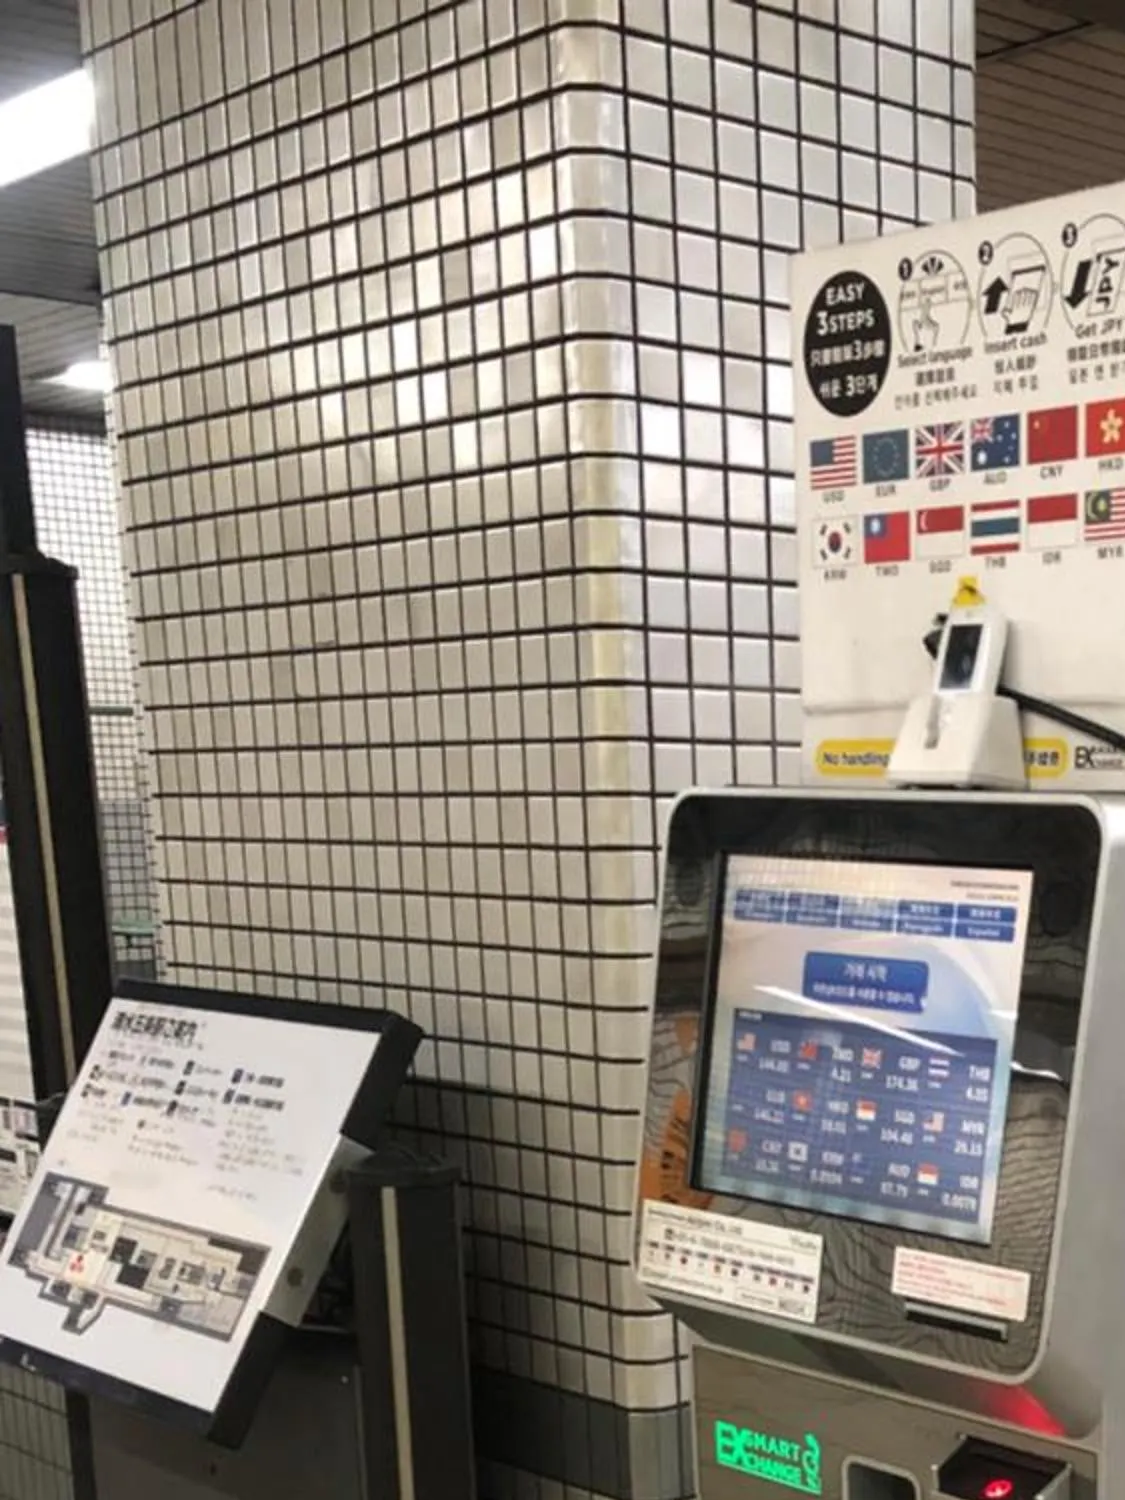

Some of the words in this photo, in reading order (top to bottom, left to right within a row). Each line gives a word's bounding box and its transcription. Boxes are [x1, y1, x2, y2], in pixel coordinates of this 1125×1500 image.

[825, 282, 866, 307] EASY
[1020, 331, 1048, 349] cash
[1074, 322, 1098, 340] Get
[1040, 465, 1064, 479] CNY
[1098, 458, 1124, 472] HKD
